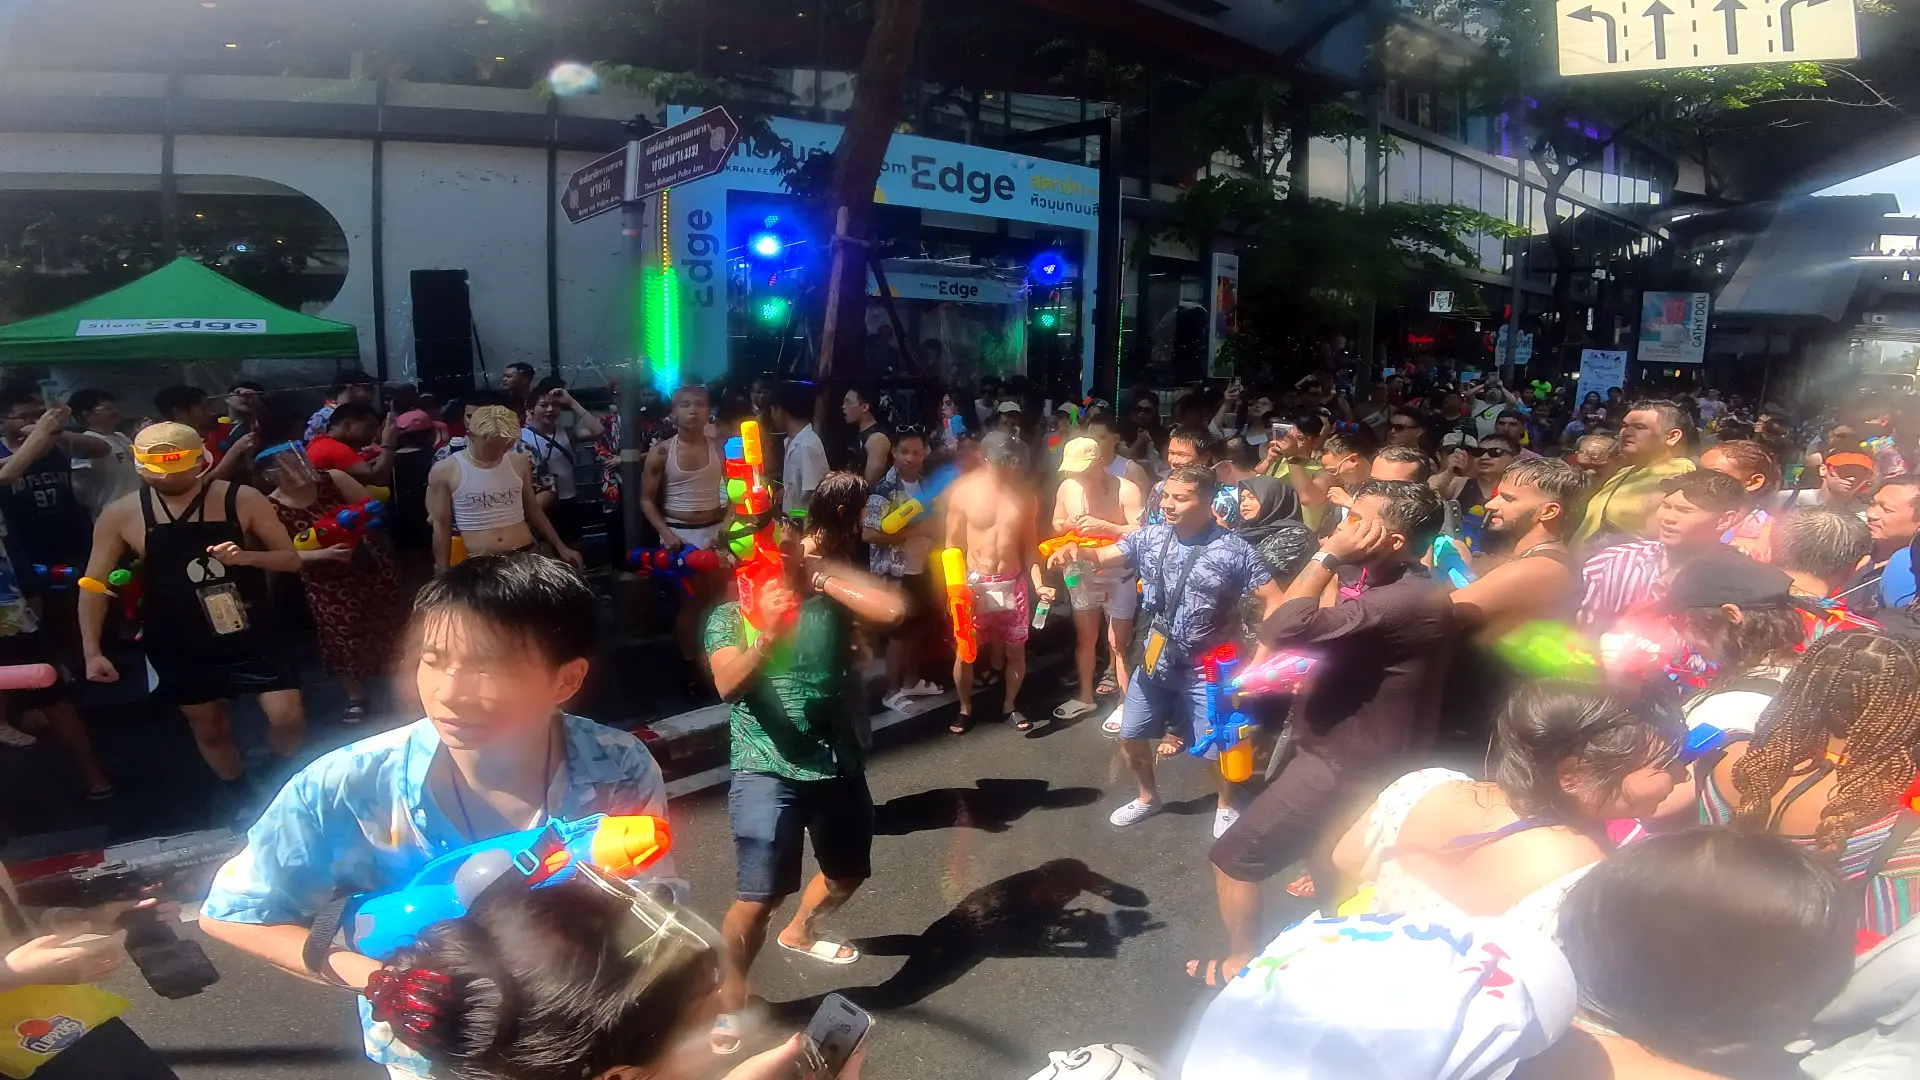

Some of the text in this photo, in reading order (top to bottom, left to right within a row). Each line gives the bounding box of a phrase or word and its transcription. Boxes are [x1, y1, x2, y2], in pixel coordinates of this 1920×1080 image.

[677, 168, 692, 179] Police
[692, 164, 704, 174] Area
[910, 154, 1016, 204] Edge
[939, 280, 979, 299] Edge
[146, 320, 259, 331] Edge
[1692, 294, 1707, 348] CATHY DOLL
